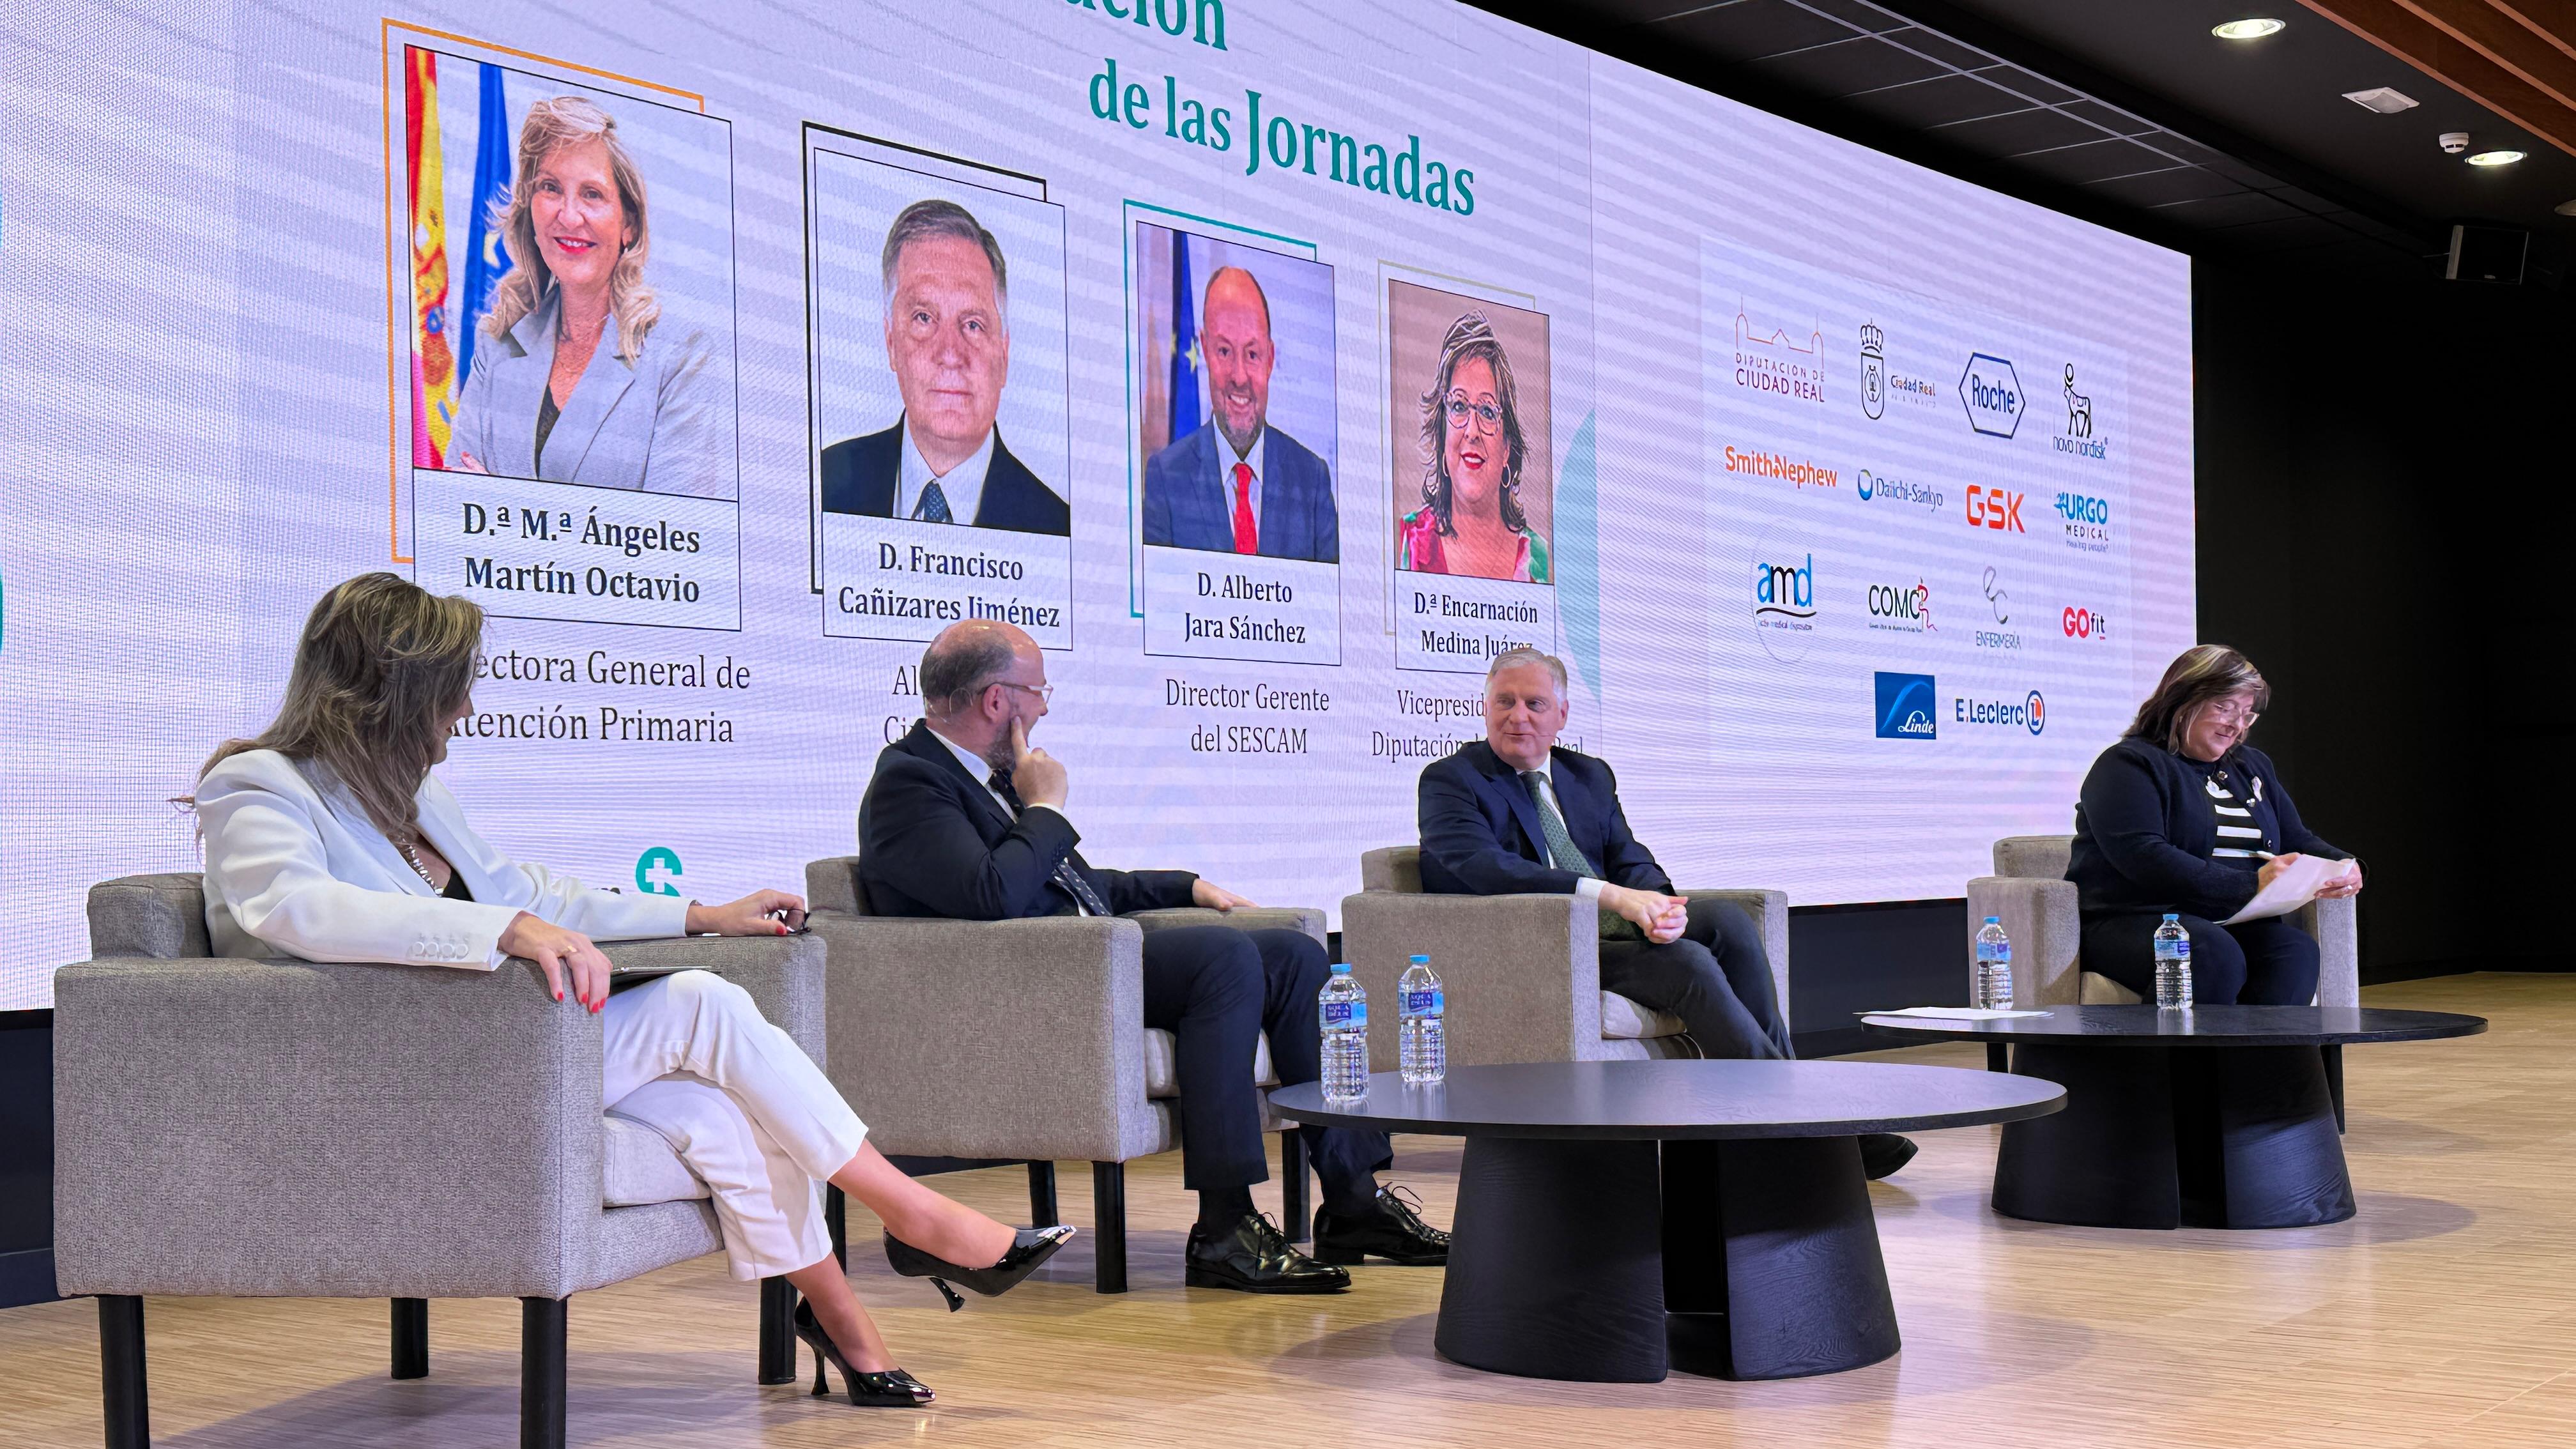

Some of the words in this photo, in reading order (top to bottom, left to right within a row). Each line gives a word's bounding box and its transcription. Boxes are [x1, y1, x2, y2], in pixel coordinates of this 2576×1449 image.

[1090, 58, 1149, 129] de
[1164, 75, 1230, 151] las
[1246, 89, 1474, 215] Jornadas
[1736, 368, 1790, 394] CIUDAD
[1795, 380, 1825, 402] REAL
[1813, 370, 1825, 382] DE
[1919, 381, 1936, 397] Real
[1972, 373, 2014, 414] Roche
[2053, 436, 2074, 453] novo
[1966, 484, 2025, 533] GSK
[2066, 493, 2108, 525] URGO
[463, 503, 510, 535] D.ª
[521, 509, 572, 541] M.ª
[581, 506, 700, 556] Ángeles
[2066, 525, 2109, 541] MEDICAL
[879, 543, 903, 571] D.
[910, 545, 1023, 580] Francisco
[464, 557, 576, 595] Martín
[586, 566, 699, 602] Octavio
[1198, 572, 1216, 597] D.
[1222, 575, 1292, 602] Alberto
[1757, 553, 1812, 607] amd
[839, 586, 961, 620] Cañizares
[1414, 592, 1437, 614] D.ª
[1442, 594, 1538, 623] Encarnación
[1185, 613, 1224, 642] Jara
[1230, 615, 1305, 643] Sánchez
[1422, 630, 1480, 654] Medina
[588, 650, 705, 687] General
[717, 656, 751, 689] de
[1166, 679, 1250, 708] Director
[1255, 684, 1329, 710] Gerente
[1398, 690, 1487, 722] Vicepresid
[600, 707, 734, 742] Primaria
[1898, 710, 1935, 734] Linde
[1956, 698, 2024, 725] E.Leclerc
[1191, 724, 1221, 752] del
[1228, 726, 1308, 753] SESCAM
